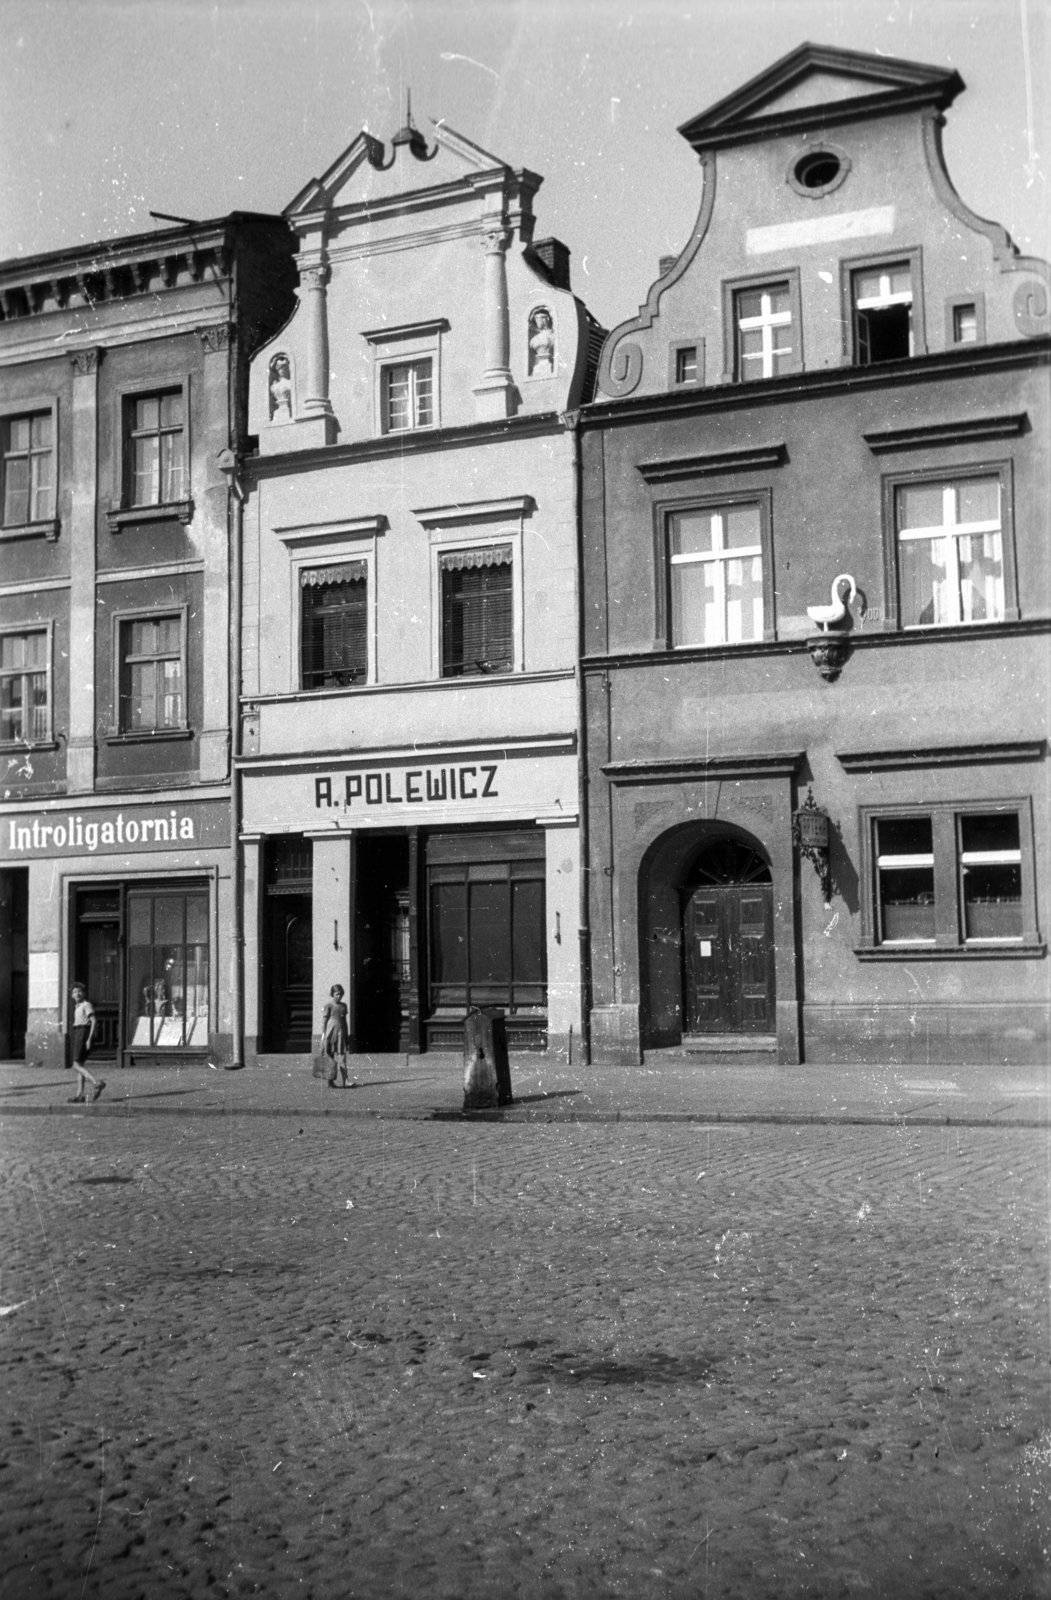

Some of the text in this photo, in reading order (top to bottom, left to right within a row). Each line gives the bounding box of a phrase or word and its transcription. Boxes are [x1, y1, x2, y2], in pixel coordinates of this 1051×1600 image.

[314, 765, 499, 808] A. POLEWICZ
[9, 810, 195, 851] Introligatornia
